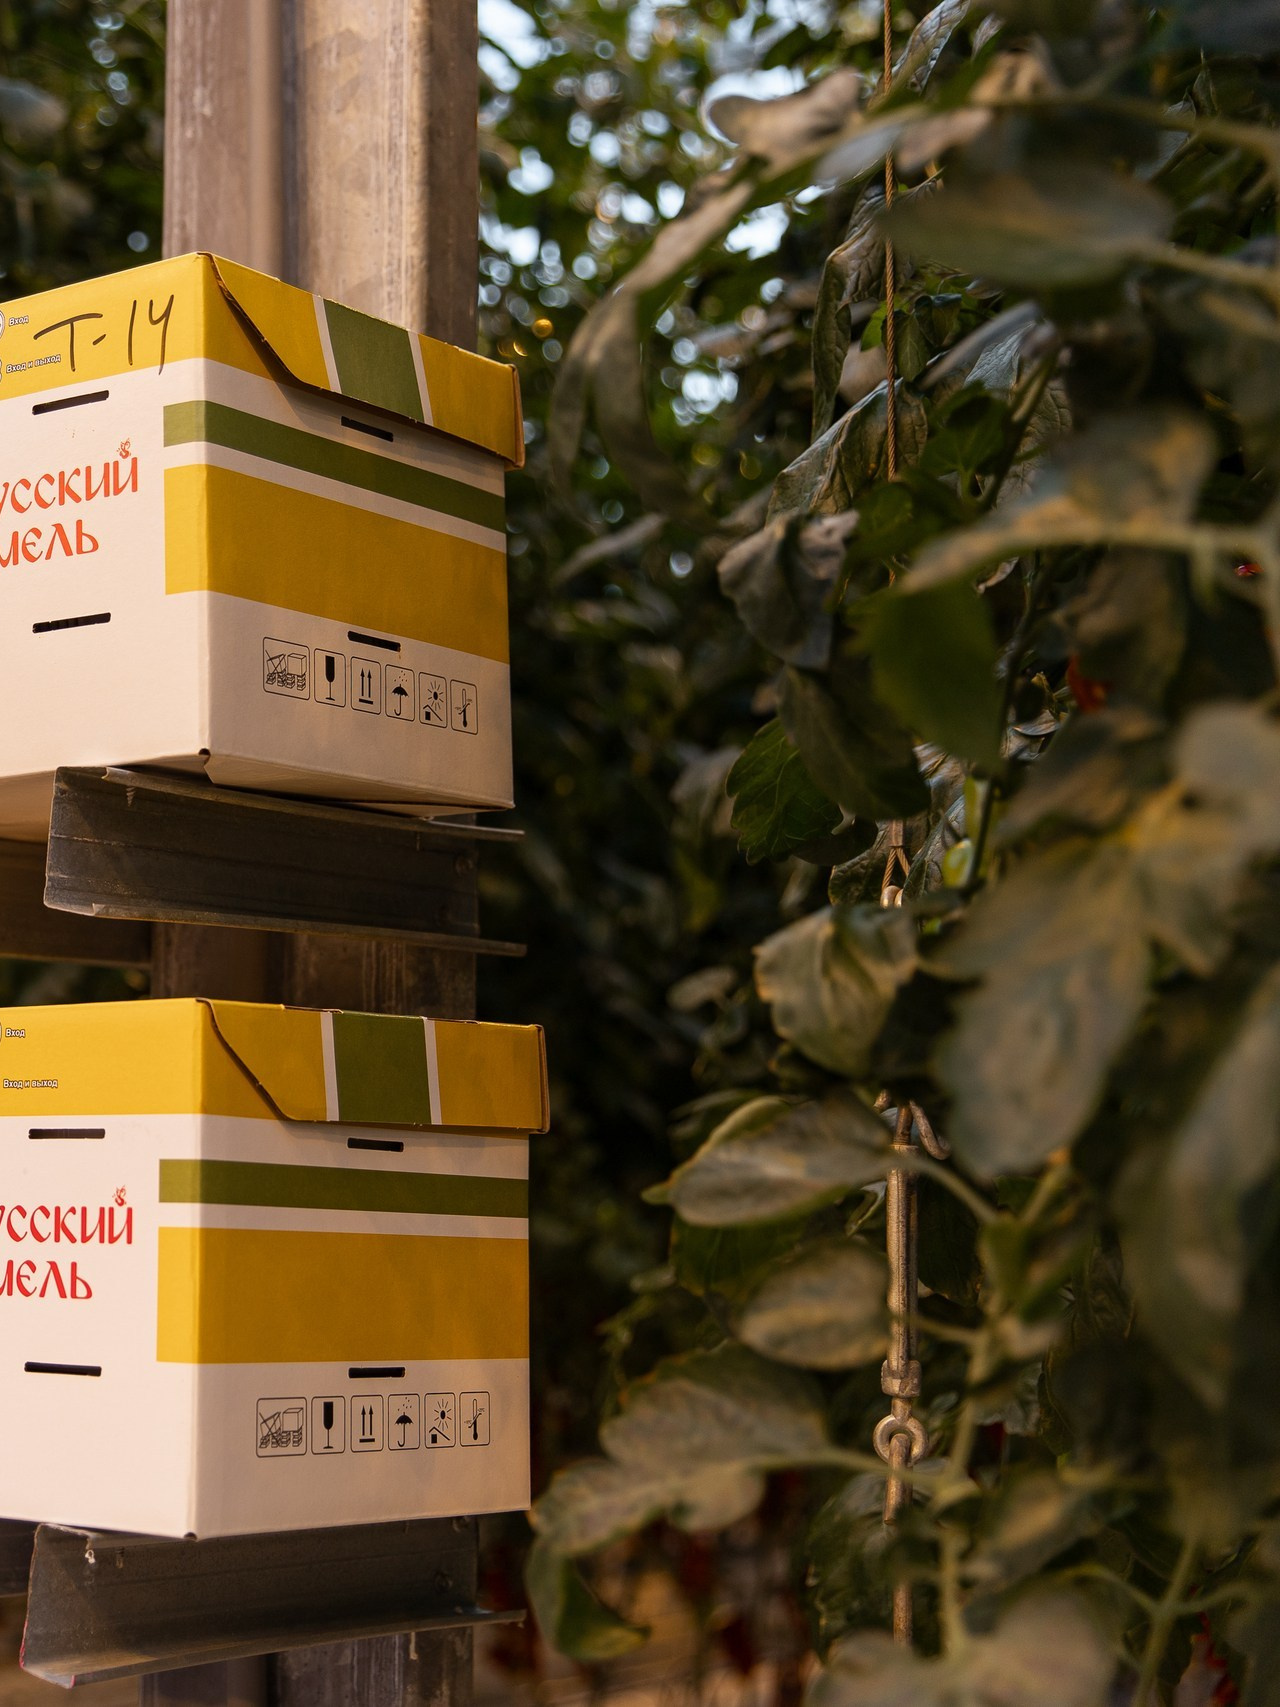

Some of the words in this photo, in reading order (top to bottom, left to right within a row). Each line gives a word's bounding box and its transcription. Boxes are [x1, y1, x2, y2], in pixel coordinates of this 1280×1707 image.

[9, 315, 29, 327] Вход
[6, 361, 27, 374] Вход
[5, 1027, 26, 1038] Вход
[3, 1078, 23, 1089] Вход
[31, 1079, 58, 1089] выход
